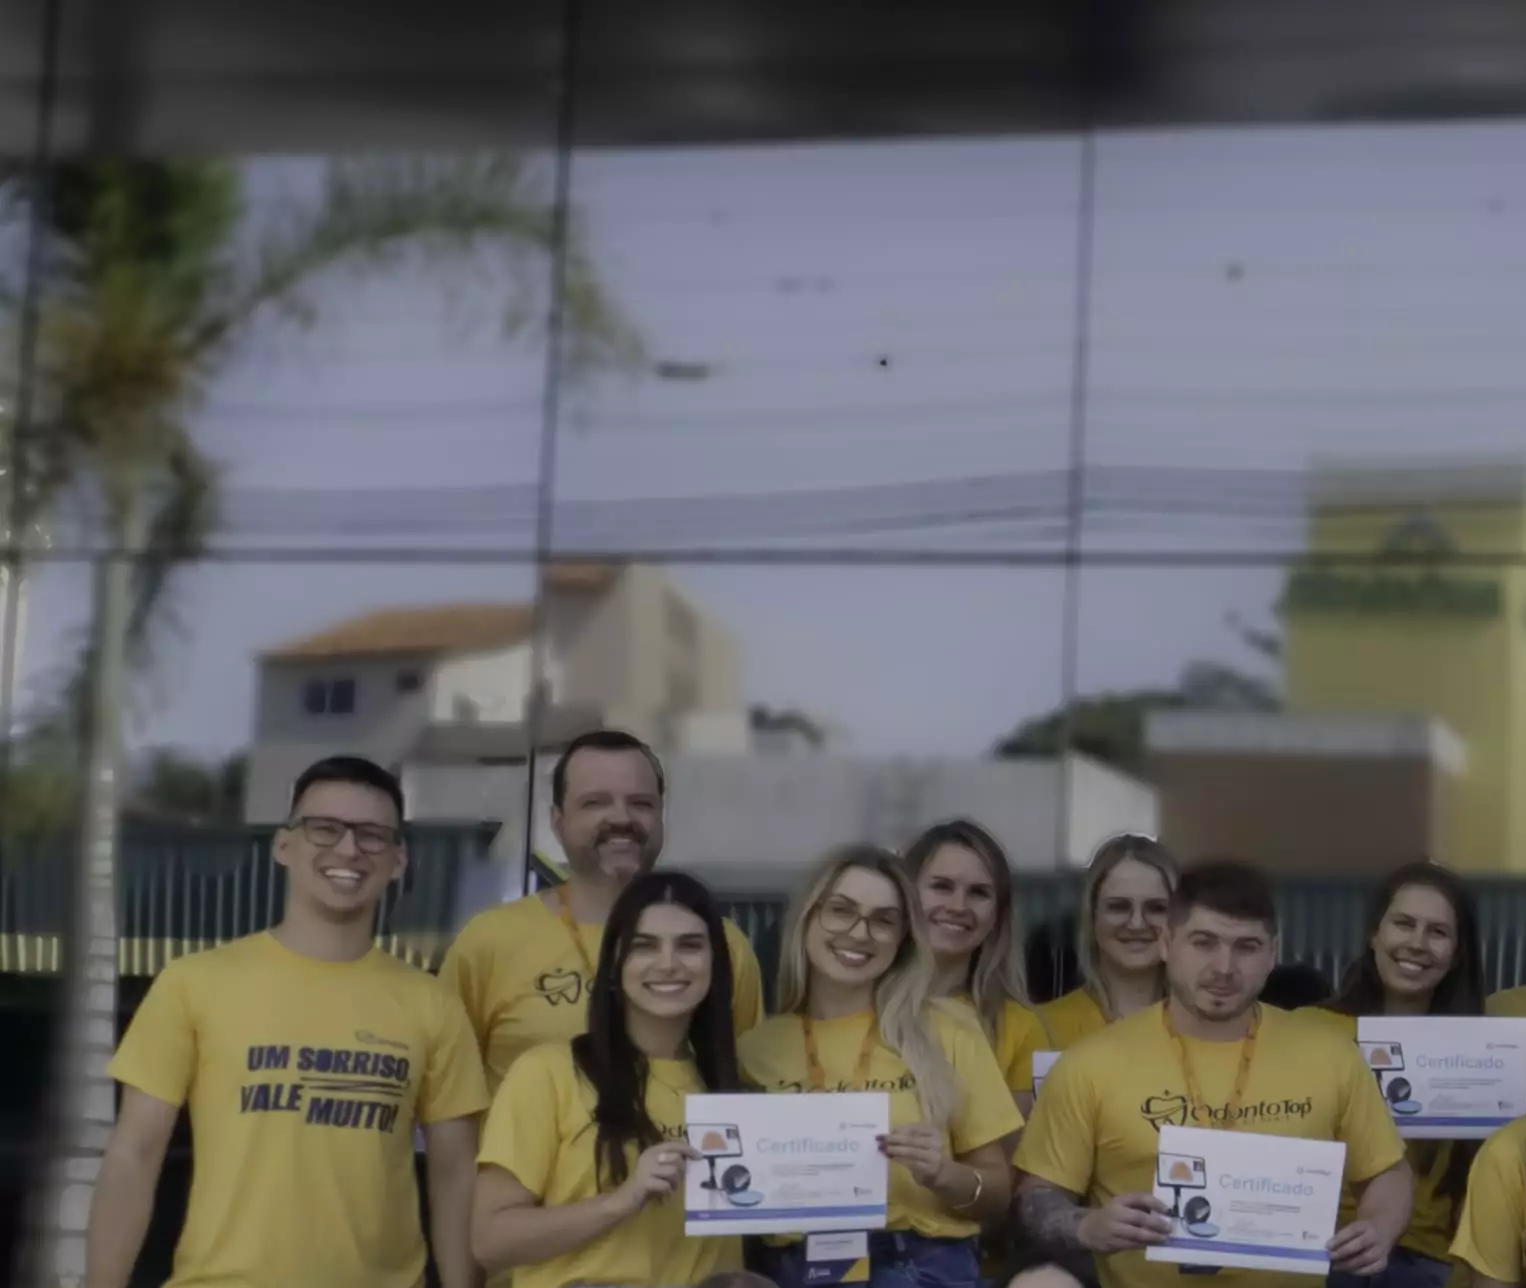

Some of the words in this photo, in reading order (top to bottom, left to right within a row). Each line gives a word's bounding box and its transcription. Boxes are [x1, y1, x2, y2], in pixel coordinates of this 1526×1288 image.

[246, 1045, 290, 1071] UM
[1415, 1055, 1505, 1070] Certificado
[239, 1082, 304, 1113] VALE
[305, 1096, 399, 1133] MUITO!
[756, 1138, 860, 1154] Certificado
[1219, 1174, 1314, 1196] Certificado
